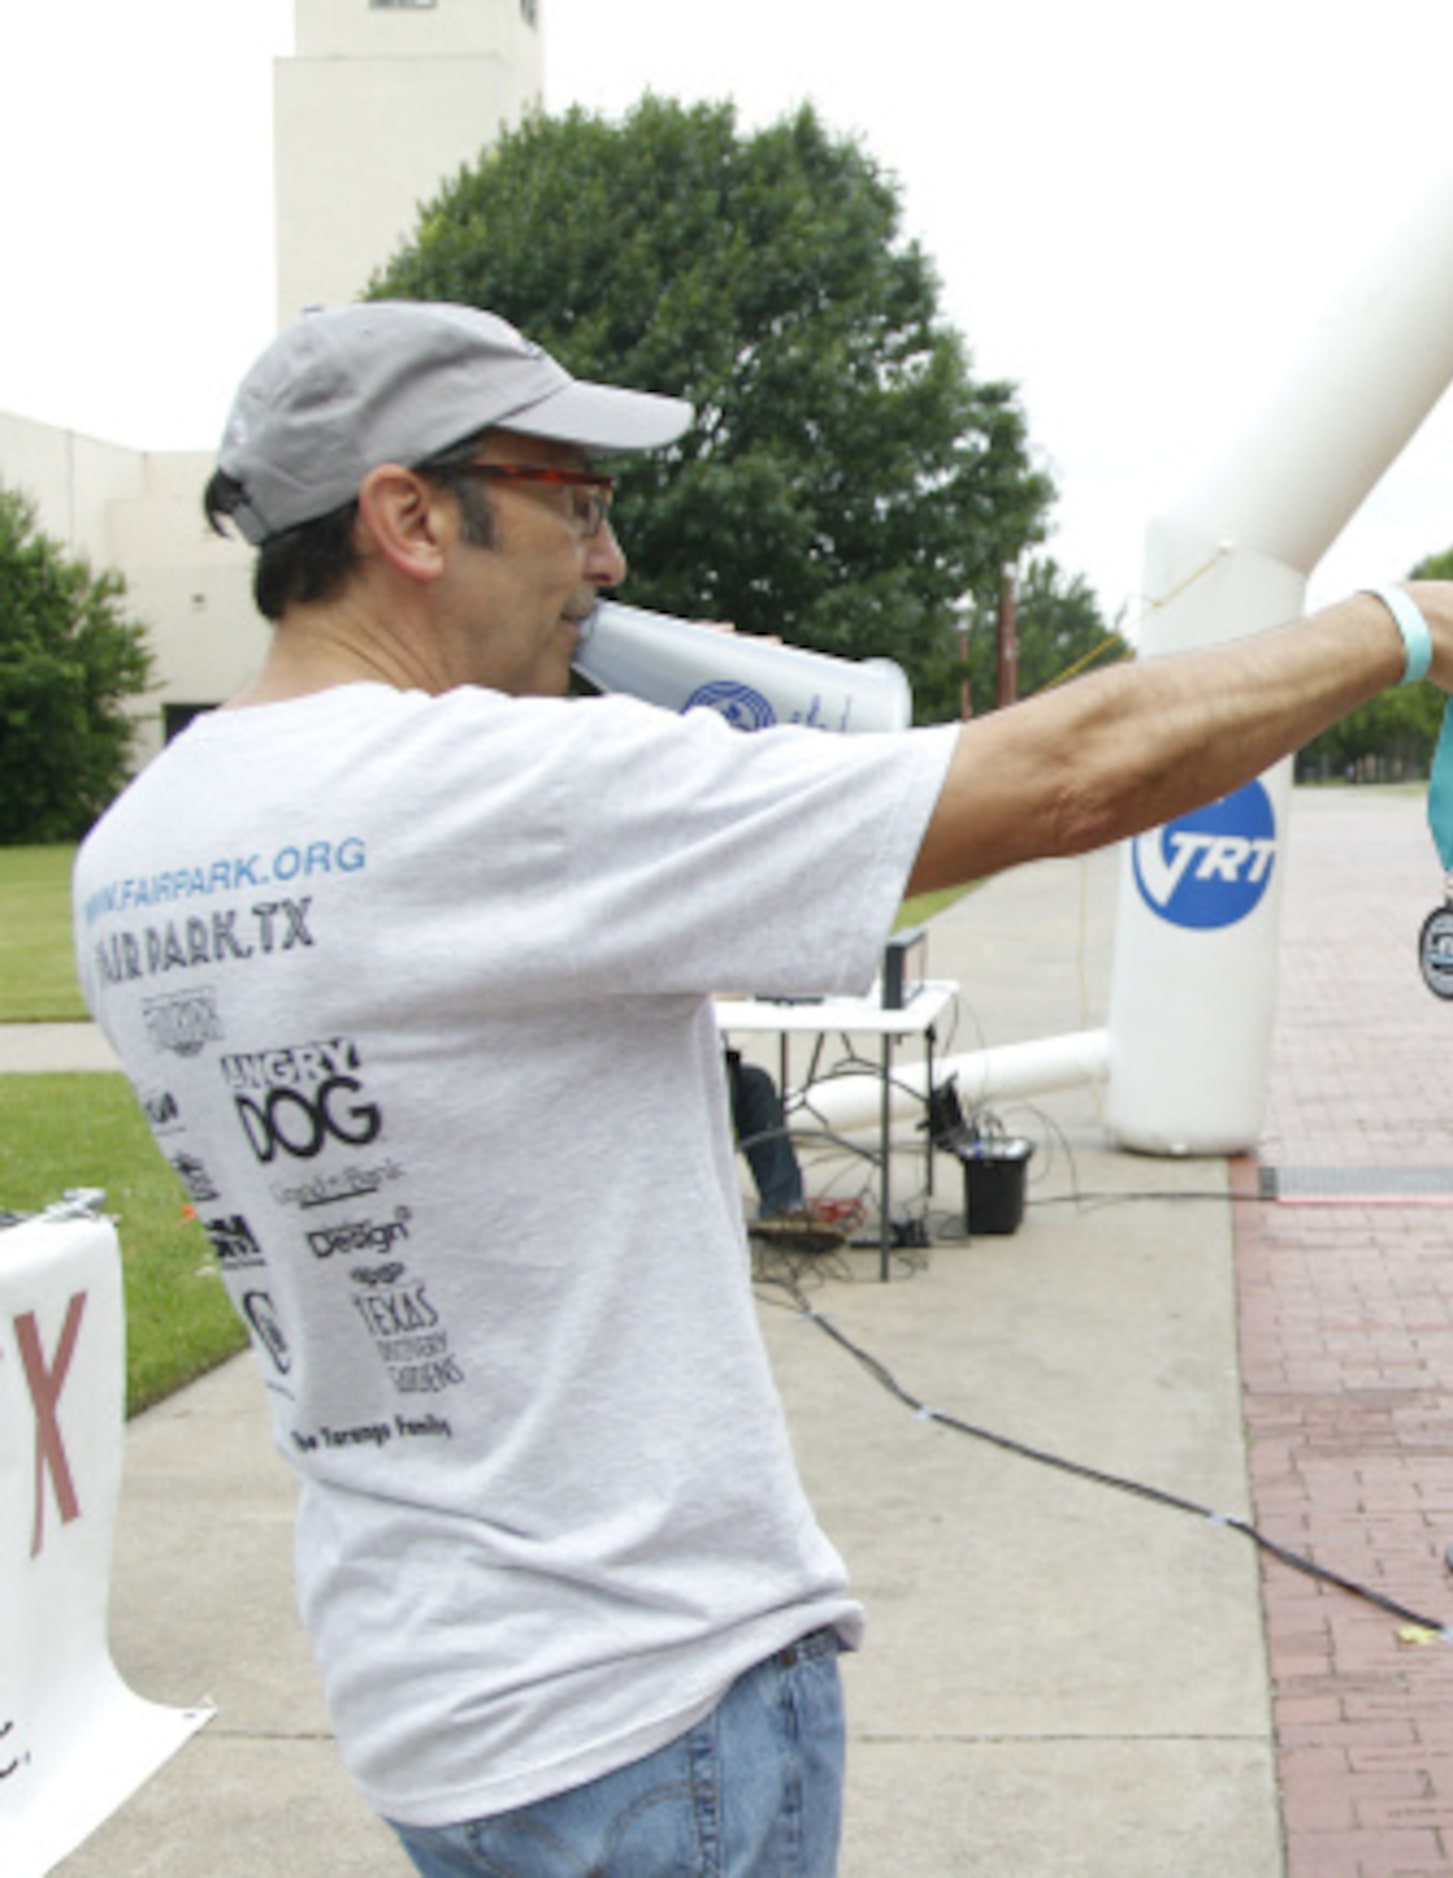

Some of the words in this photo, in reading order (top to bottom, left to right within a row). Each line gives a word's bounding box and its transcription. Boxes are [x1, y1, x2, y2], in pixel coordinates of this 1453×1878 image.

[1170, 832, 1279, 886] TRT
[220, 1037, 361, 1090] ANGRY
[234, 1076, 382, 1166] DOG
[353, 1285, 438, 1336] TEXAS
[0, 1289, 88, 1560] X
